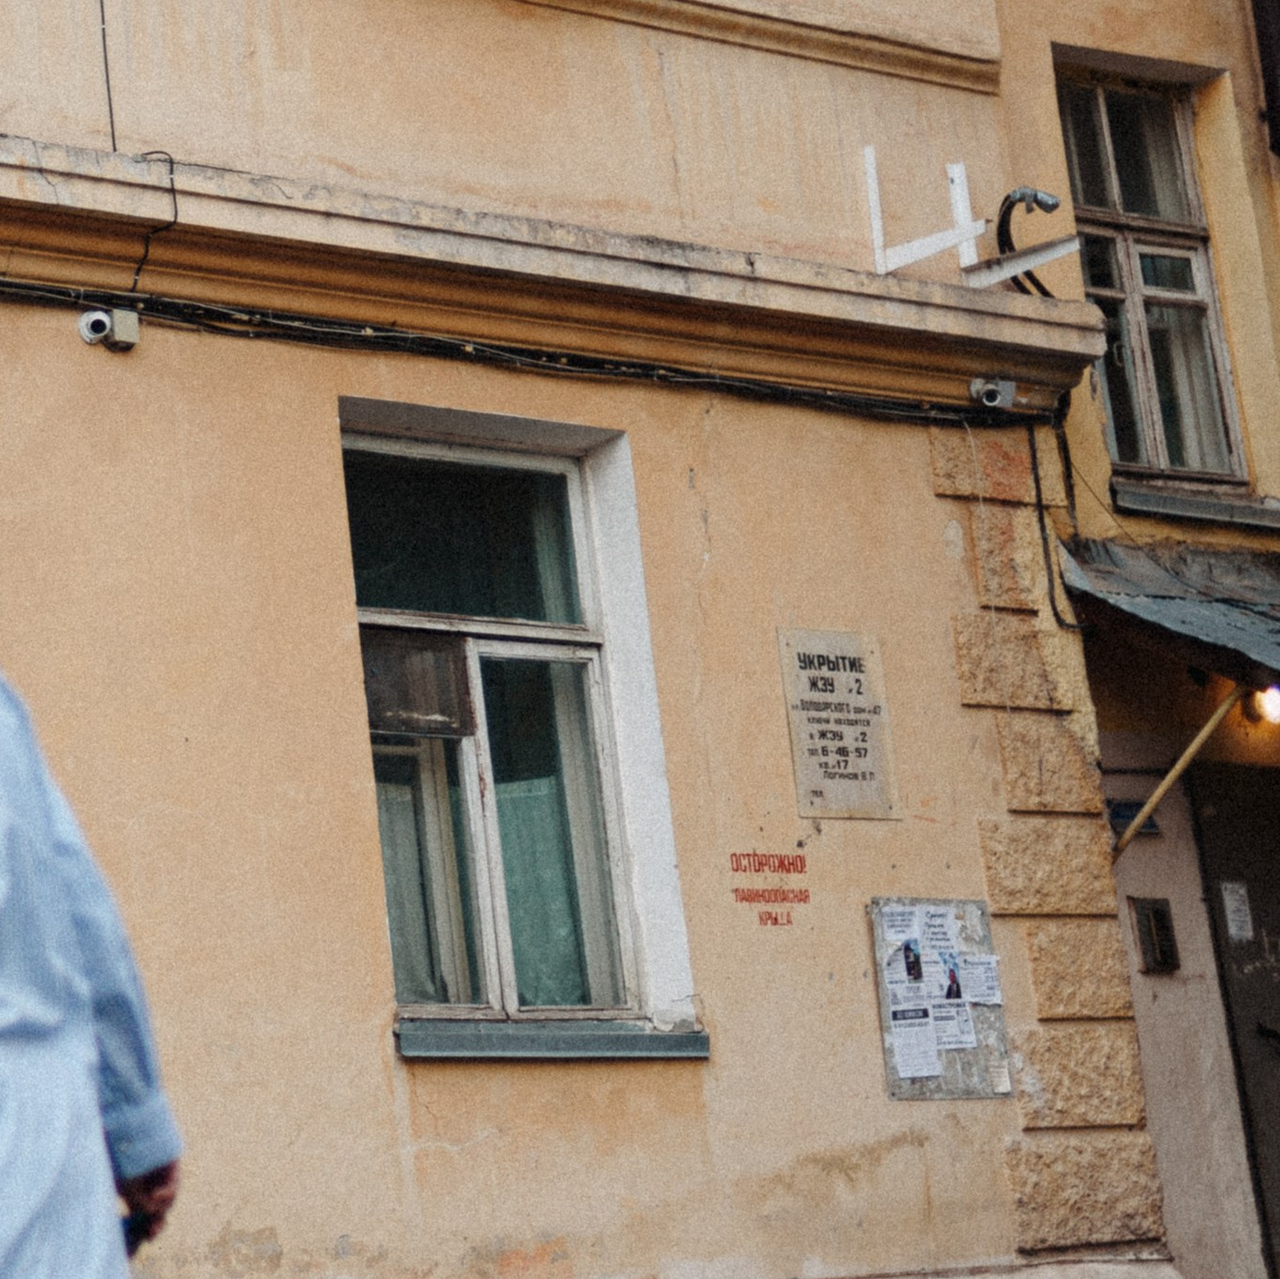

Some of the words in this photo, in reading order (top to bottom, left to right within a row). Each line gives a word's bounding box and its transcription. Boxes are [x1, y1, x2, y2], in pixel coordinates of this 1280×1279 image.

[797, 652, 865, 673] УКРЫТИЕ
[808, 676, 835, 694] ЖЭУ
[818, 730, 843, 741] ЖЭУ
[821, 746, 868, 758] 6-46-57
[730, 853, 807, 874] ОСТОРОЖНО!
